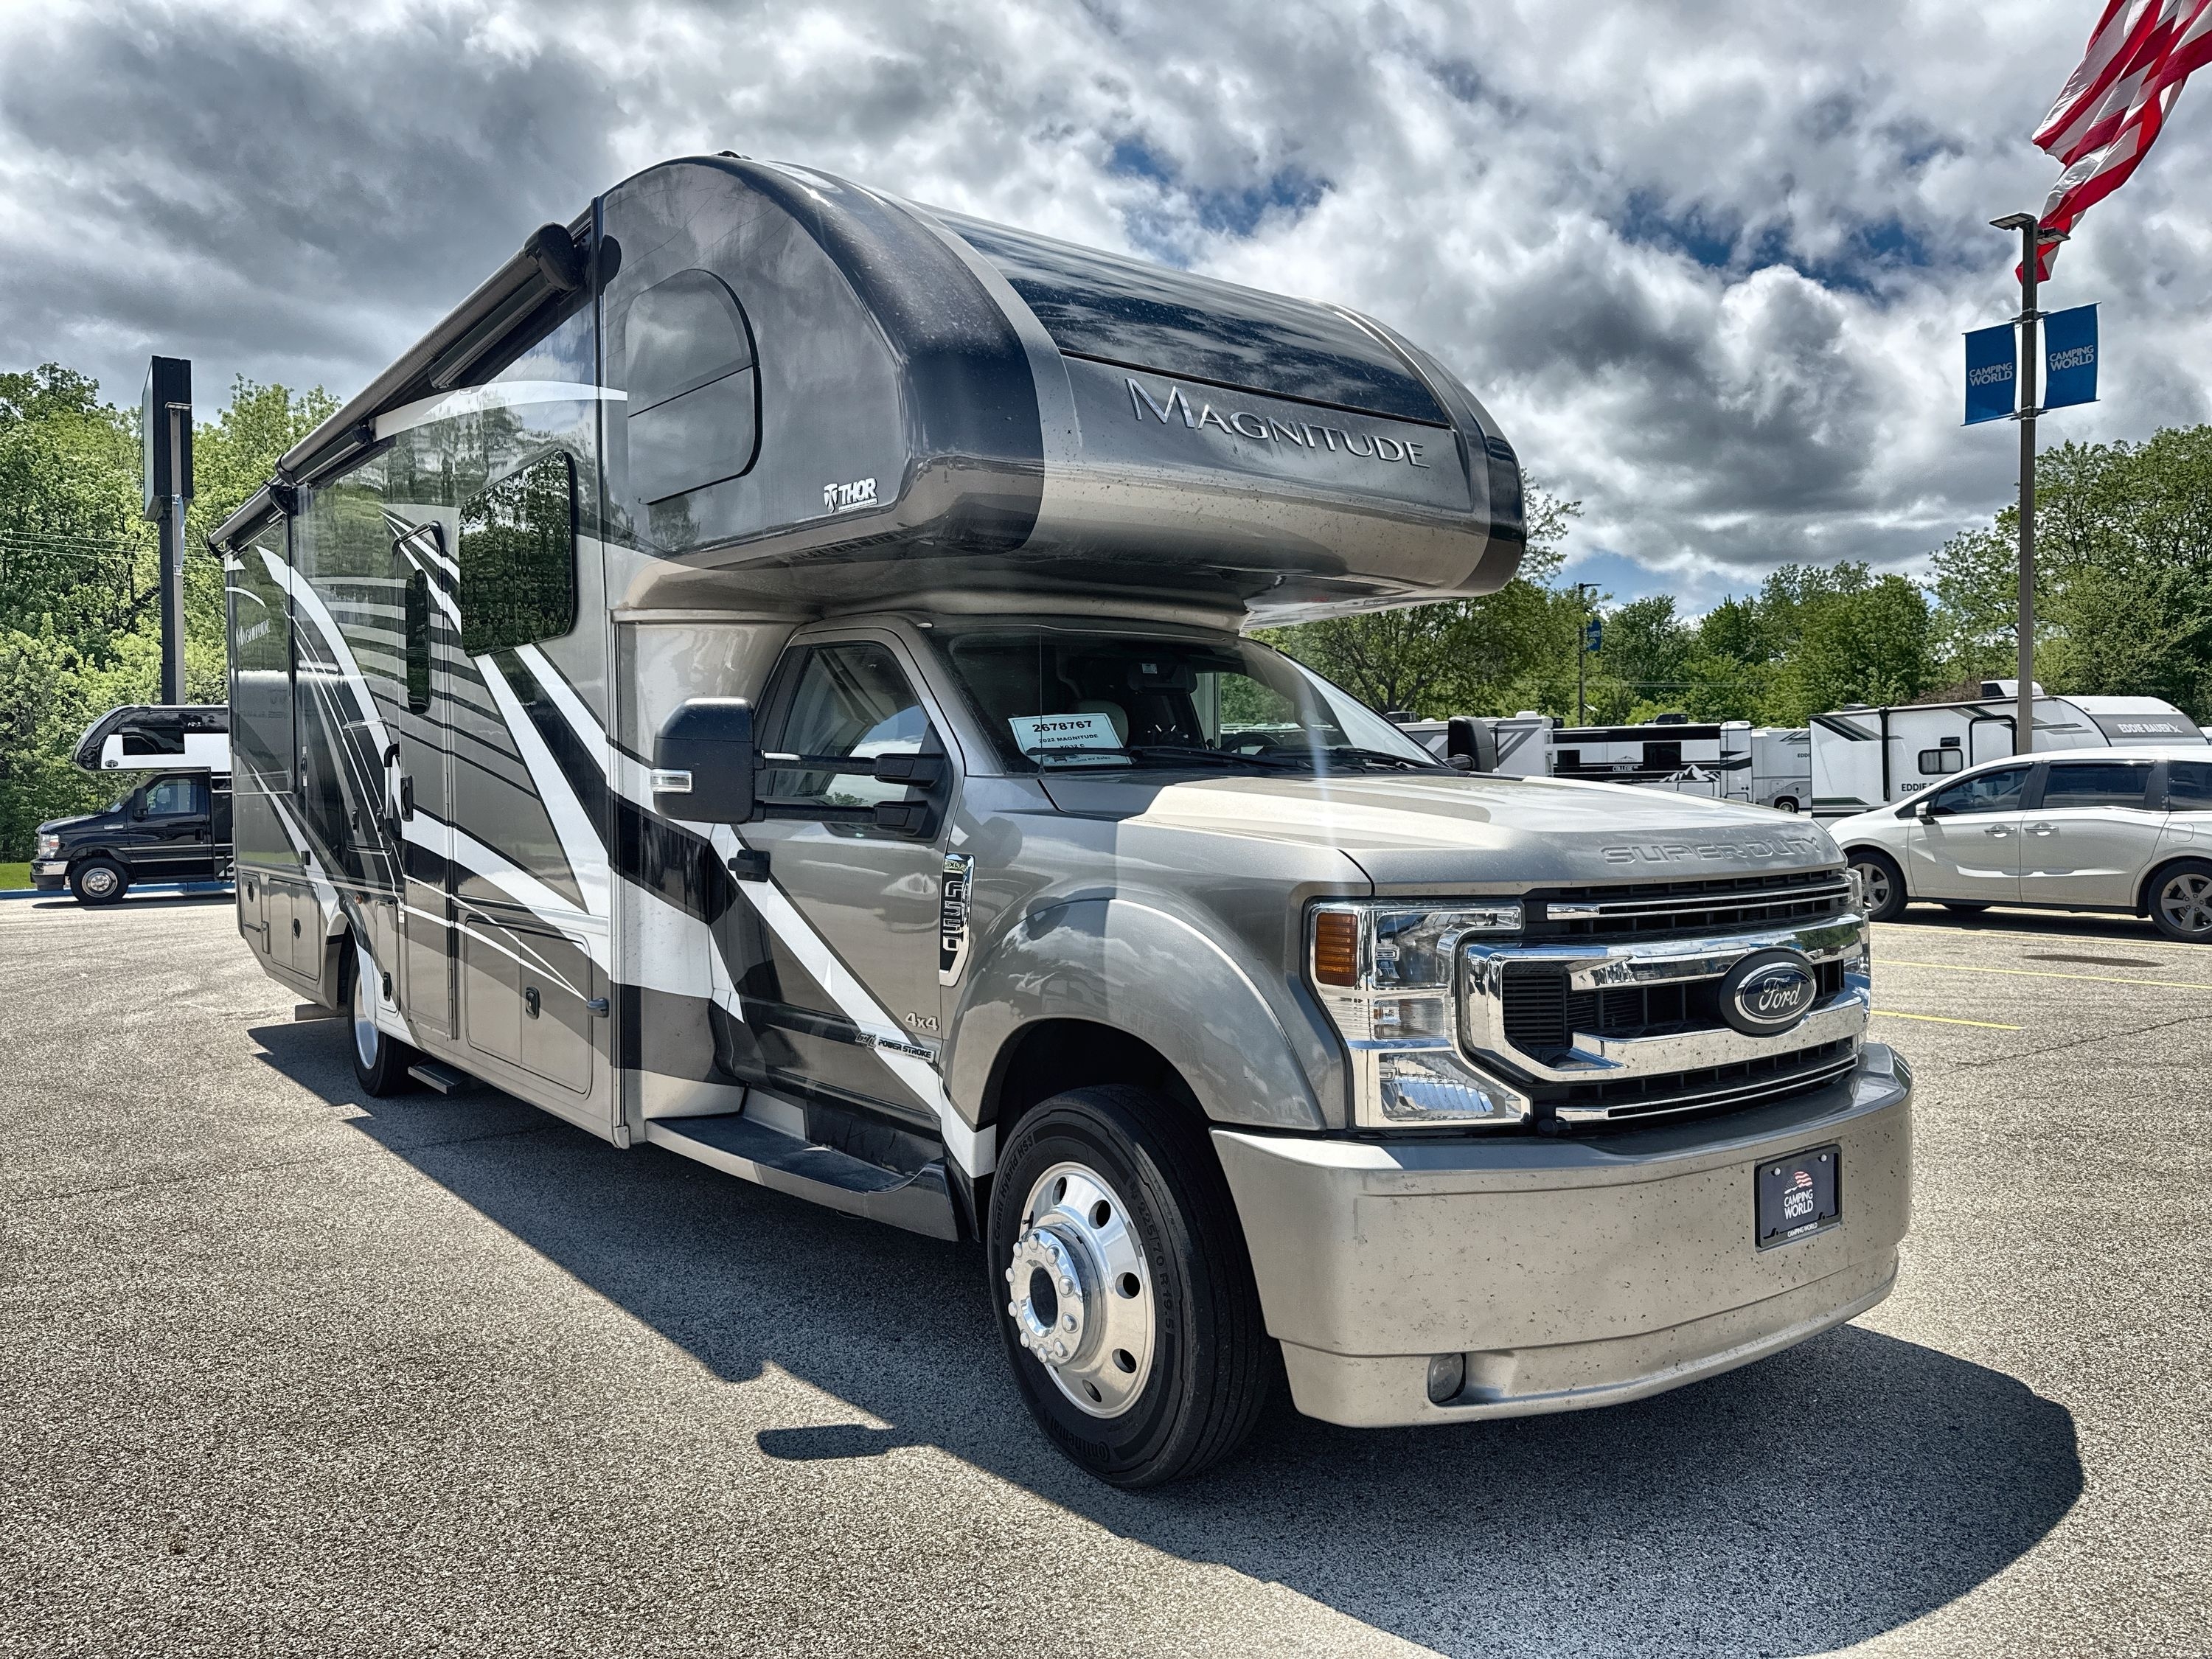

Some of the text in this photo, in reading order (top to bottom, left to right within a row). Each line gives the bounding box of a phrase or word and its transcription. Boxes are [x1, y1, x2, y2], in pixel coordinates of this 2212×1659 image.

[2049, 344, 2094, 362] CAMPING
[2050, 353, 2094, 372] WORLD
[1969, 362, 2013, 378] CAMPING
[1969, 370, 2013, 386] WORLD
[1125, 377, 1430, 469] MAGNITUDE
[838, 478, 877, 506] THOR
[1032, 720, 1092, 733] 2678767
[2117, 723, 2172, 734] EDDIE BAUER
[1057, 734, 1099, 742] MAGNITUDE
[1601, 837, 1821, 865] SUPER DUTY
[949, 861, 962, 869] XLT
[1759, 976, 1801, 1011] Ford
[905, 1012, 939, 1031] 4x4
[878, 1039, 902, 1051] POWER
[902, 1045, 932, 1059] STROKE
[995, 1135, 1034, 1240] Conti Hybrid HS3
[1784, 1189, 1813, 1208] CAMPING
[1784, 1200, 1814, 1220] WORLD
[1787, 1222, 1818, 1237] CAMPING WORLD
